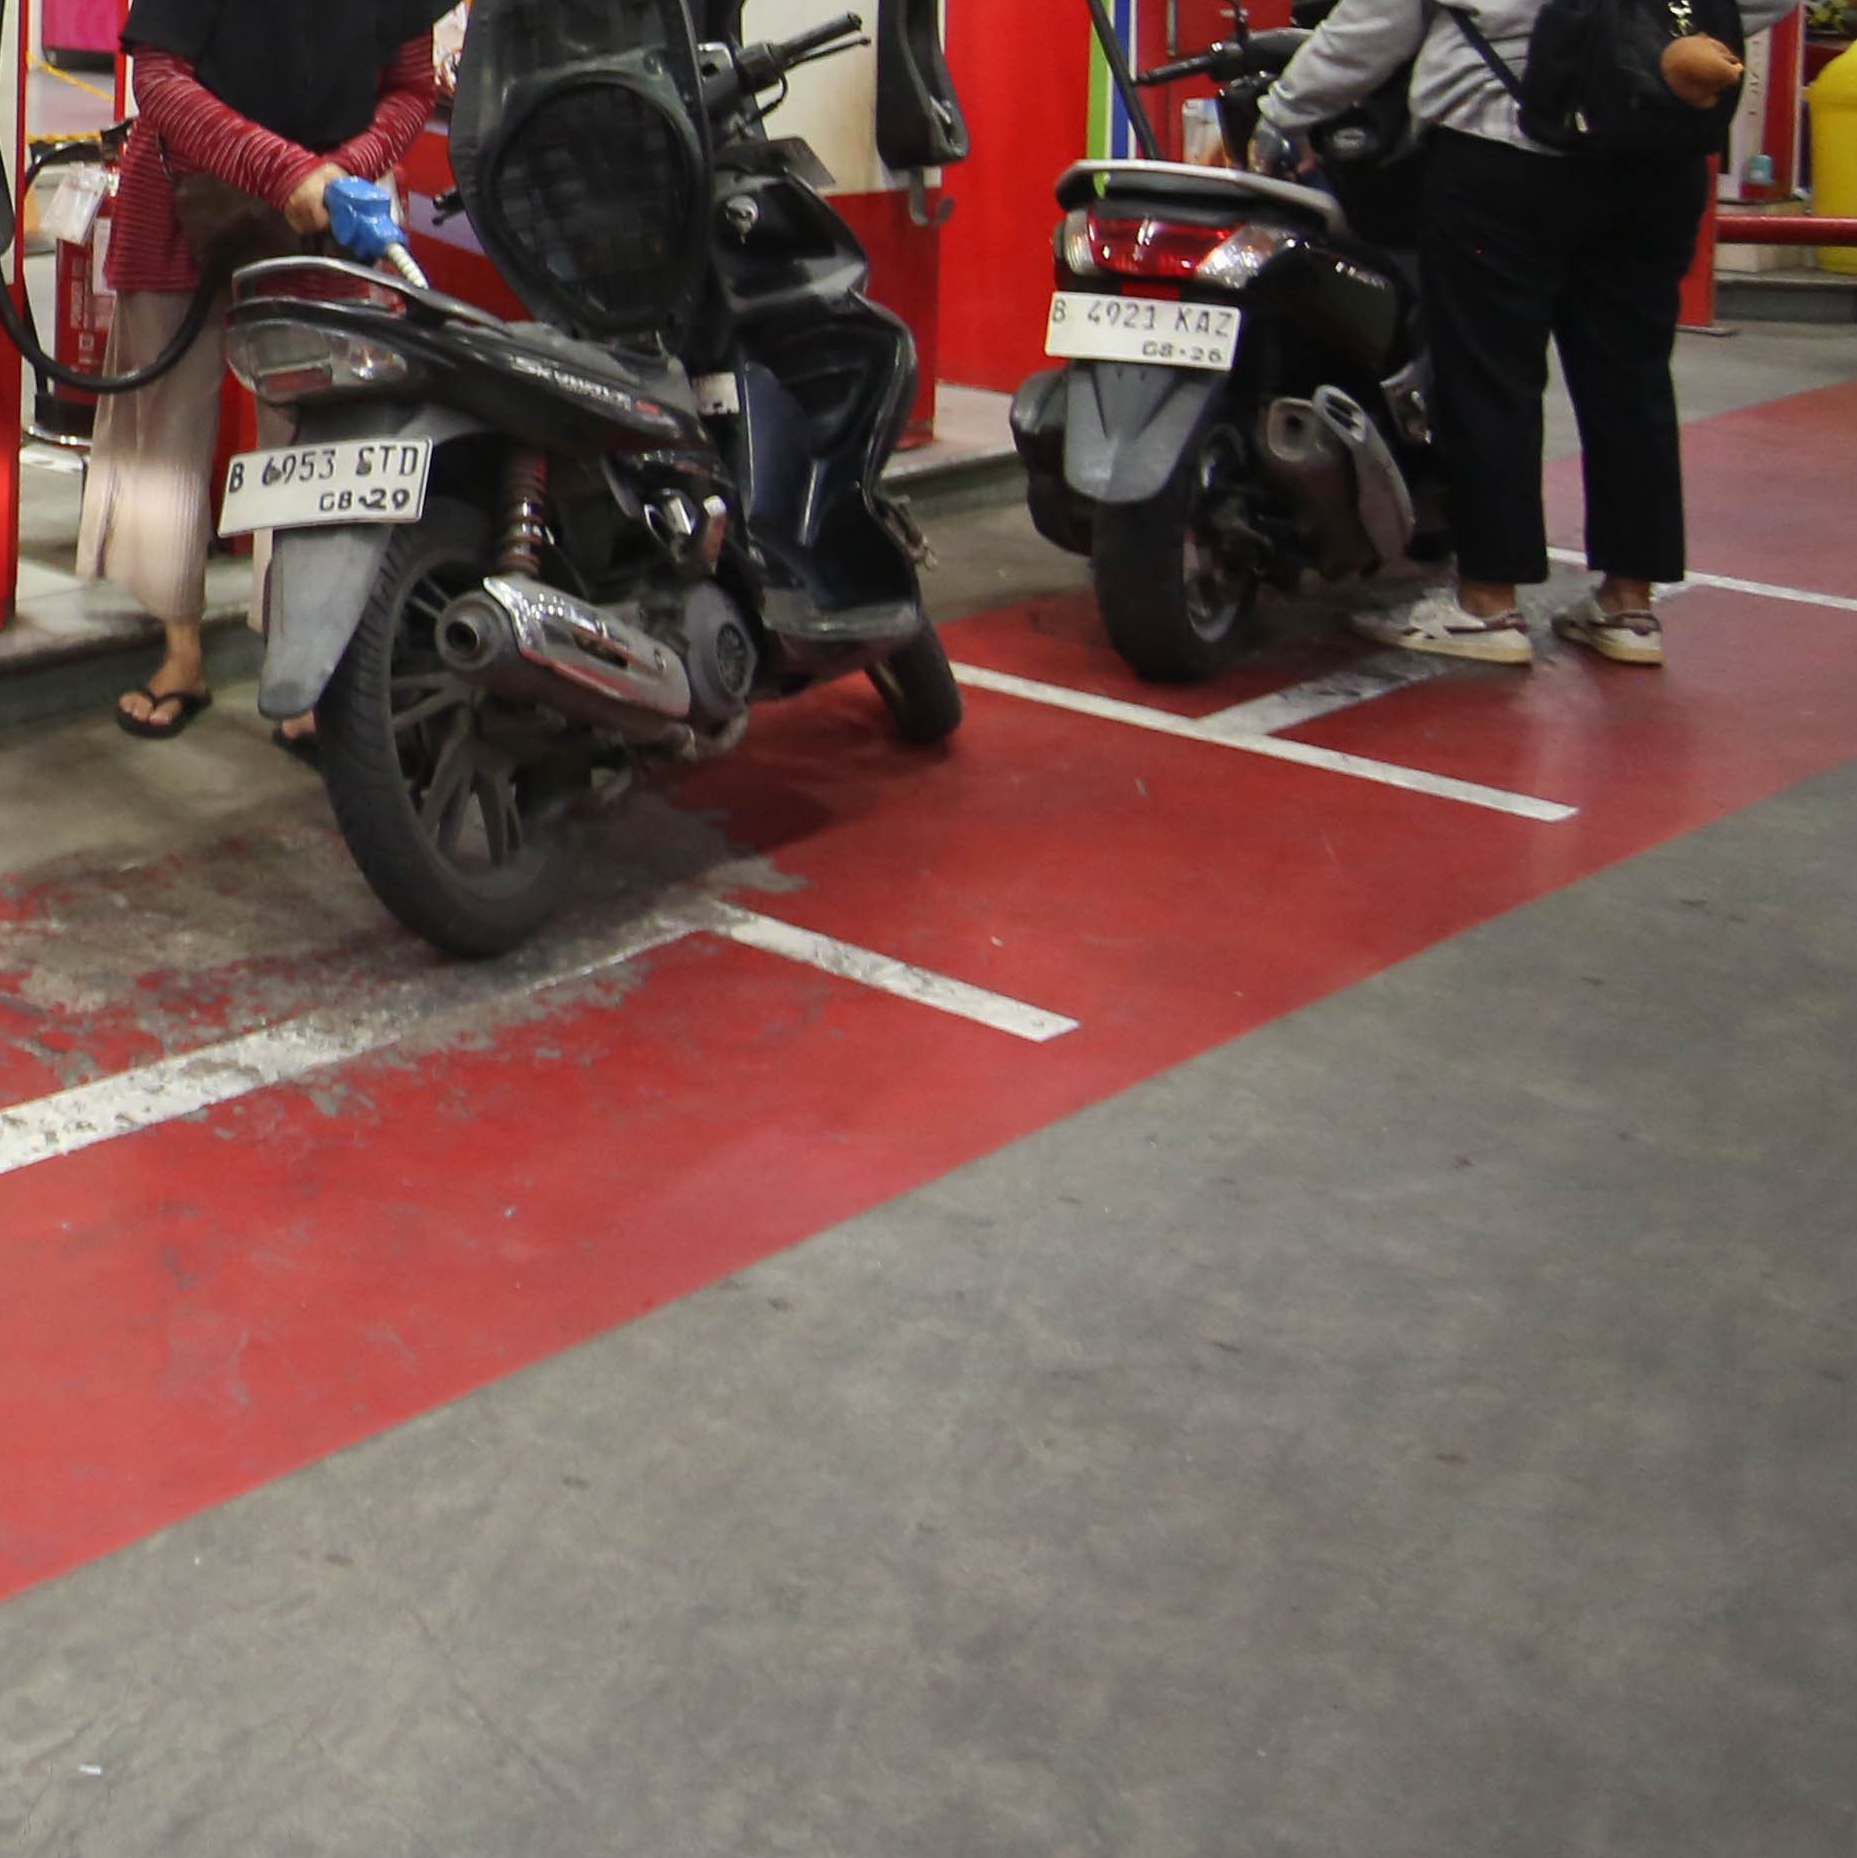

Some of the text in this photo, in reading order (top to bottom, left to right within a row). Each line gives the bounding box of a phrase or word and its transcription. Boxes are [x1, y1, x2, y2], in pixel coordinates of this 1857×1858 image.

[1051, 299, 1234, 339] B 4921 KAZ
[228, 463, 246, 495] B
[261, 449, 337, 488] 6953
